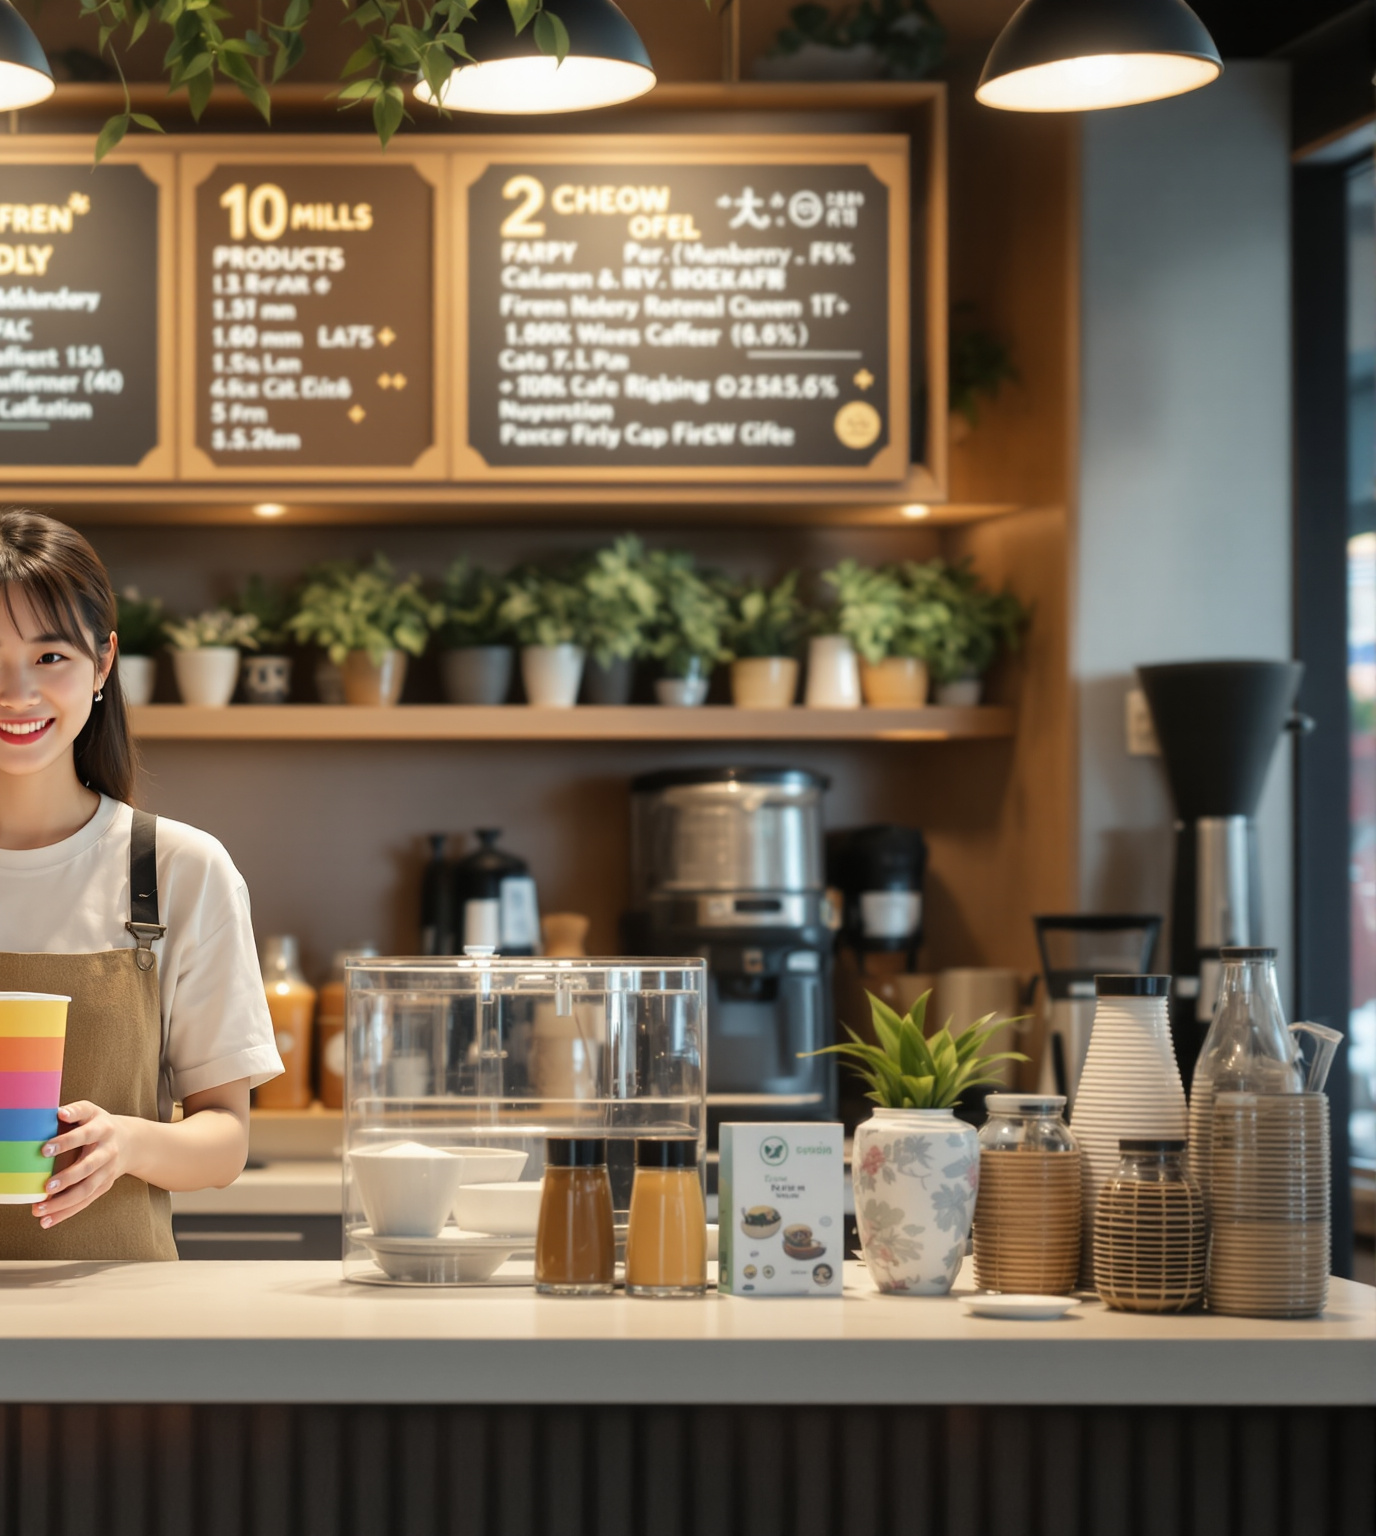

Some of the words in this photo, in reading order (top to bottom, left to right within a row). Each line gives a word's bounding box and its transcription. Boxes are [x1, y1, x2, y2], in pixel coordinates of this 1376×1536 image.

[220, 183, 288, 242] 10
[291, 202, 373, 231] MILLS
[501, 174, 546, 238] 2
[551, 184, 671, 215] CHEOW
[628, 214, 702, 241] OFEL
[212, 246, 345, 272] PRODUCTS
